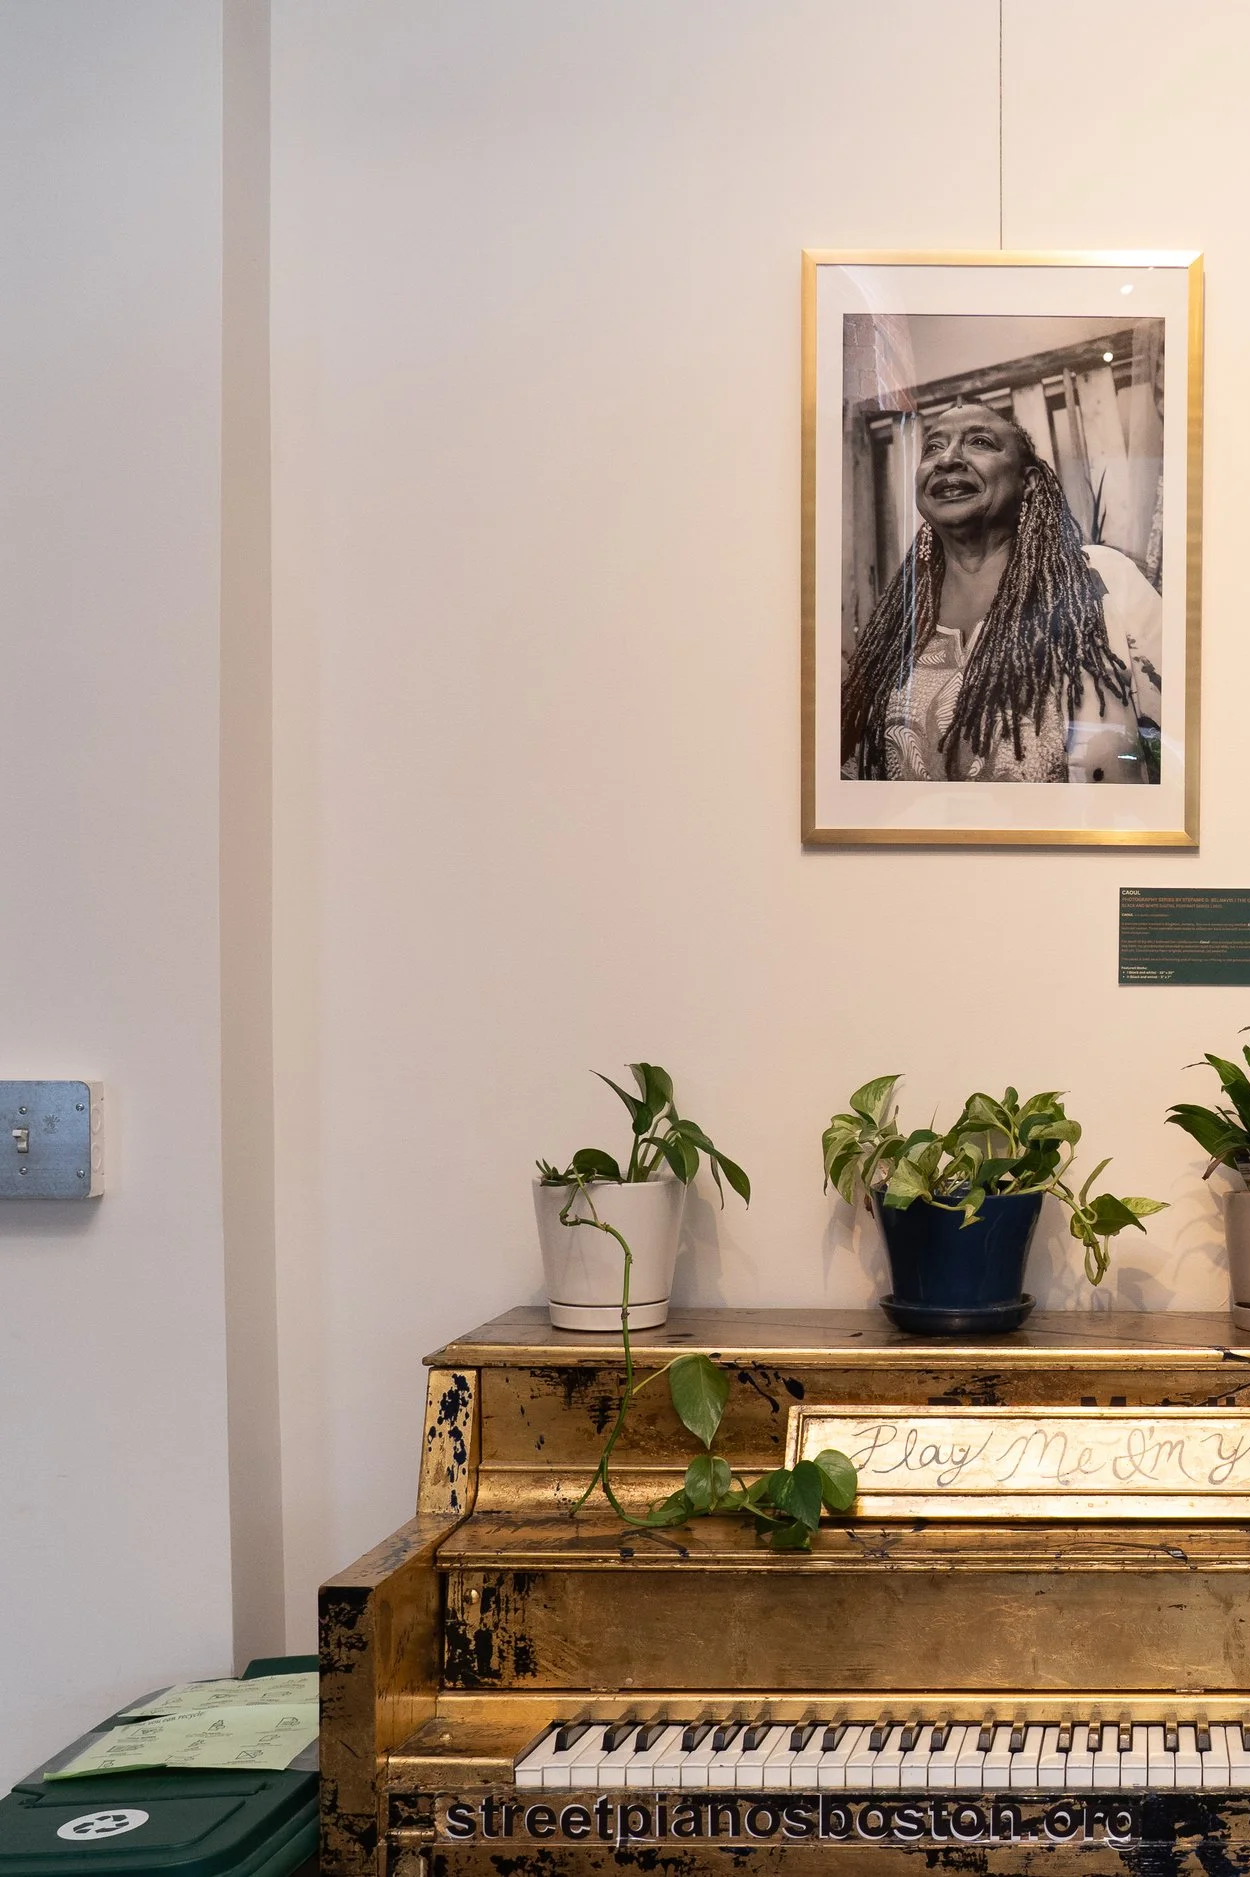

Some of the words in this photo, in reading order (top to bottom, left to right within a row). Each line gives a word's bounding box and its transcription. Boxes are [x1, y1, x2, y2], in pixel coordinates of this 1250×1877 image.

[849, 1424, 994, 1488] Play
[996, 1428, 1105, 1486] Me
[445, 1792, 1142, 1849] streetpianosboston.org
